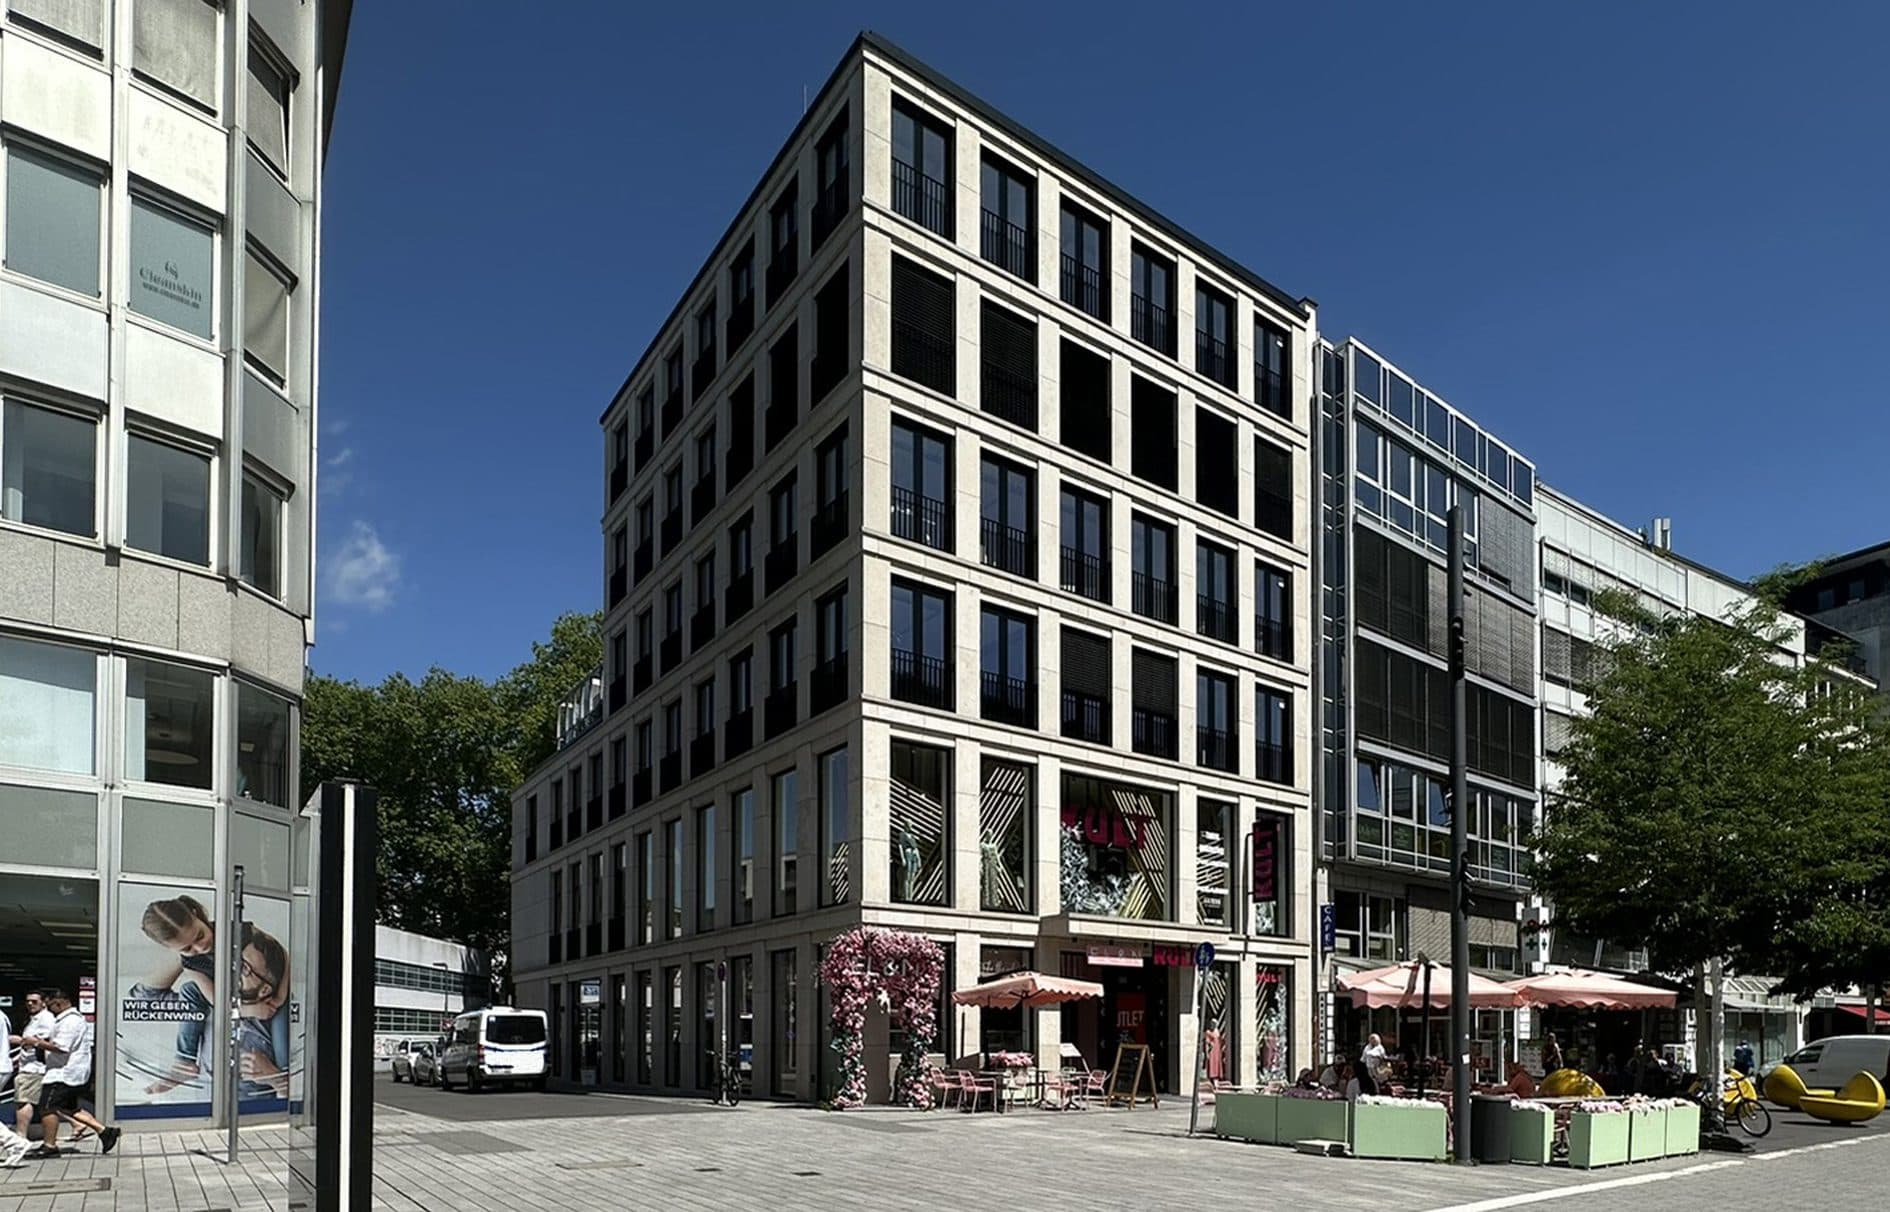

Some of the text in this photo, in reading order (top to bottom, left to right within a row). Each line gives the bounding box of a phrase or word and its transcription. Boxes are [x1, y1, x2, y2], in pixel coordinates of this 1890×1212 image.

[124, 1001, 189, 1010] WIR GEBEN
[124, 1010, 205, 1020] RÜCKENWIND
